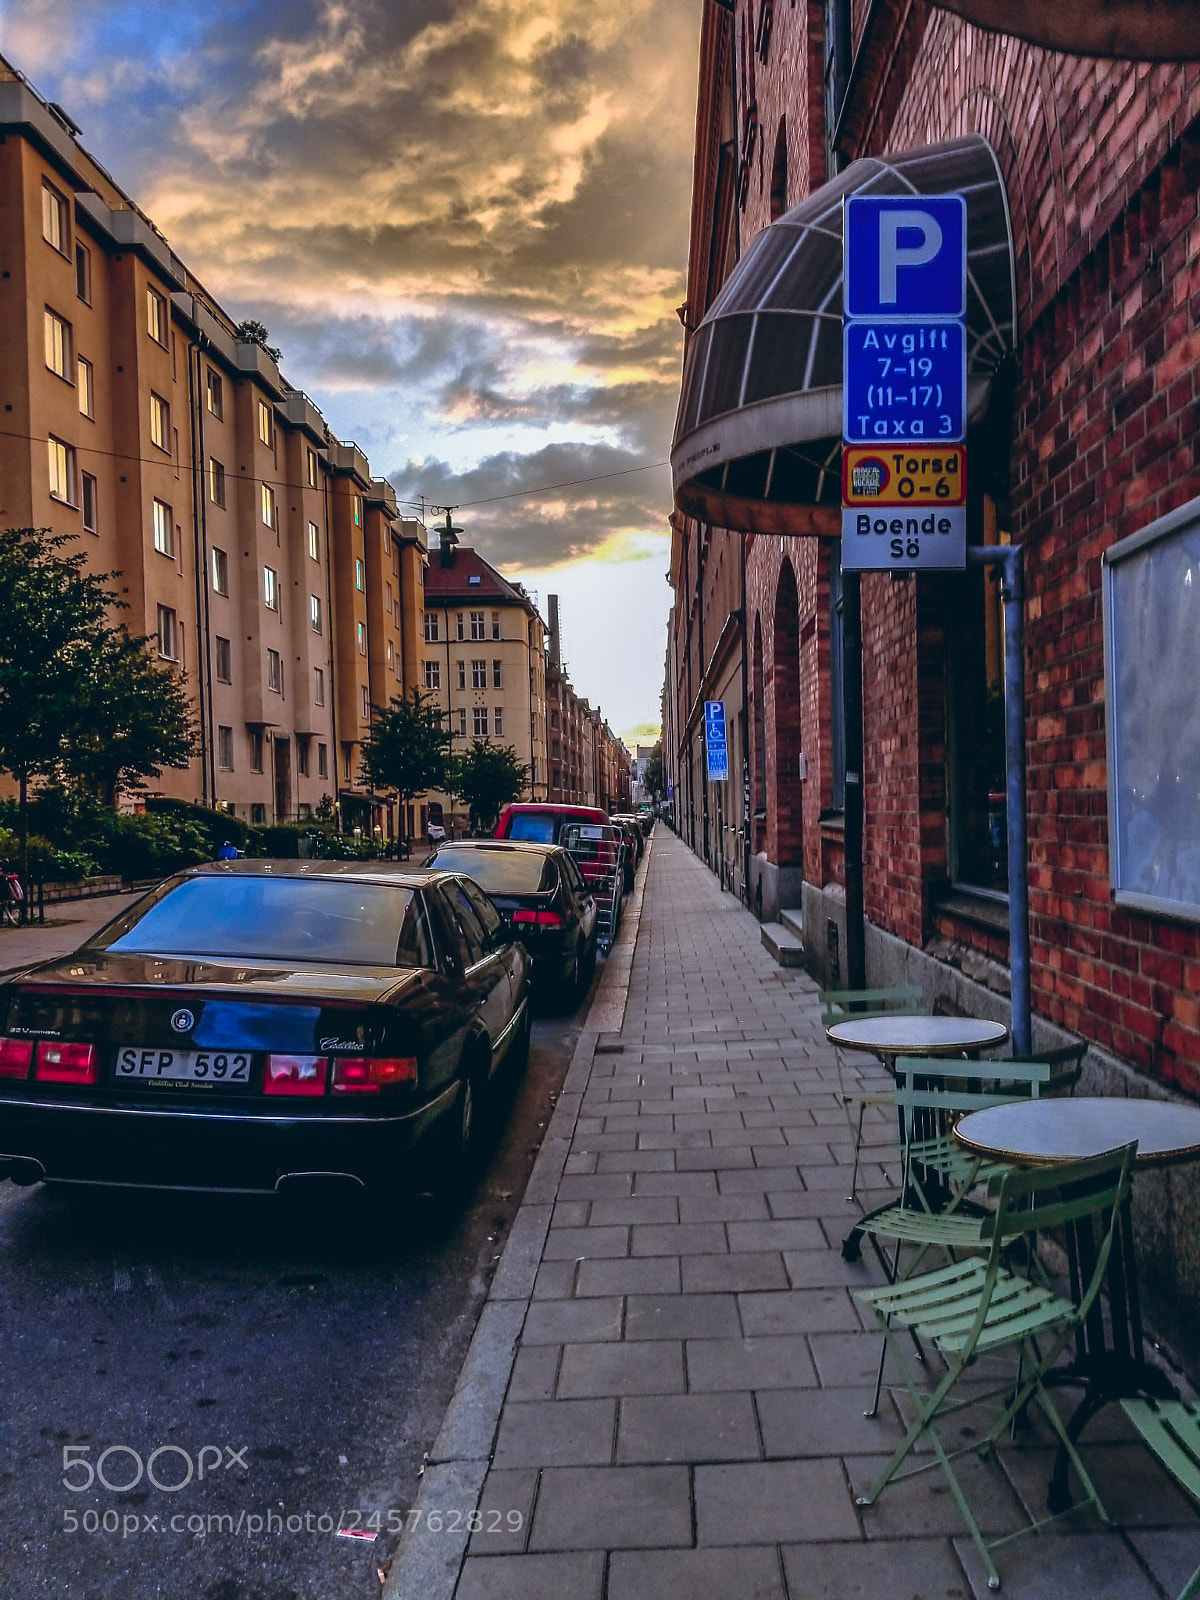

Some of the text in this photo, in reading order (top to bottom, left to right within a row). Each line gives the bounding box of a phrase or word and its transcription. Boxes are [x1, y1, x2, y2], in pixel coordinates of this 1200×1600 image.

[879, 210, 943, 304] P
[863, 328, 948, 354] Avgift
[877, 357, 933, 377] 7-19
[867, 384, 943, 408] (11-17)
[857, 414, 953, 435] Taxa 3
[892, 453, 959, 474] Torsd
[856, 513, 952, 535] Boende
[890, 537, 920, 558] Sö
[710, 703, 721, 719] P
[120, 1049, 247, 1079] SFP 592
